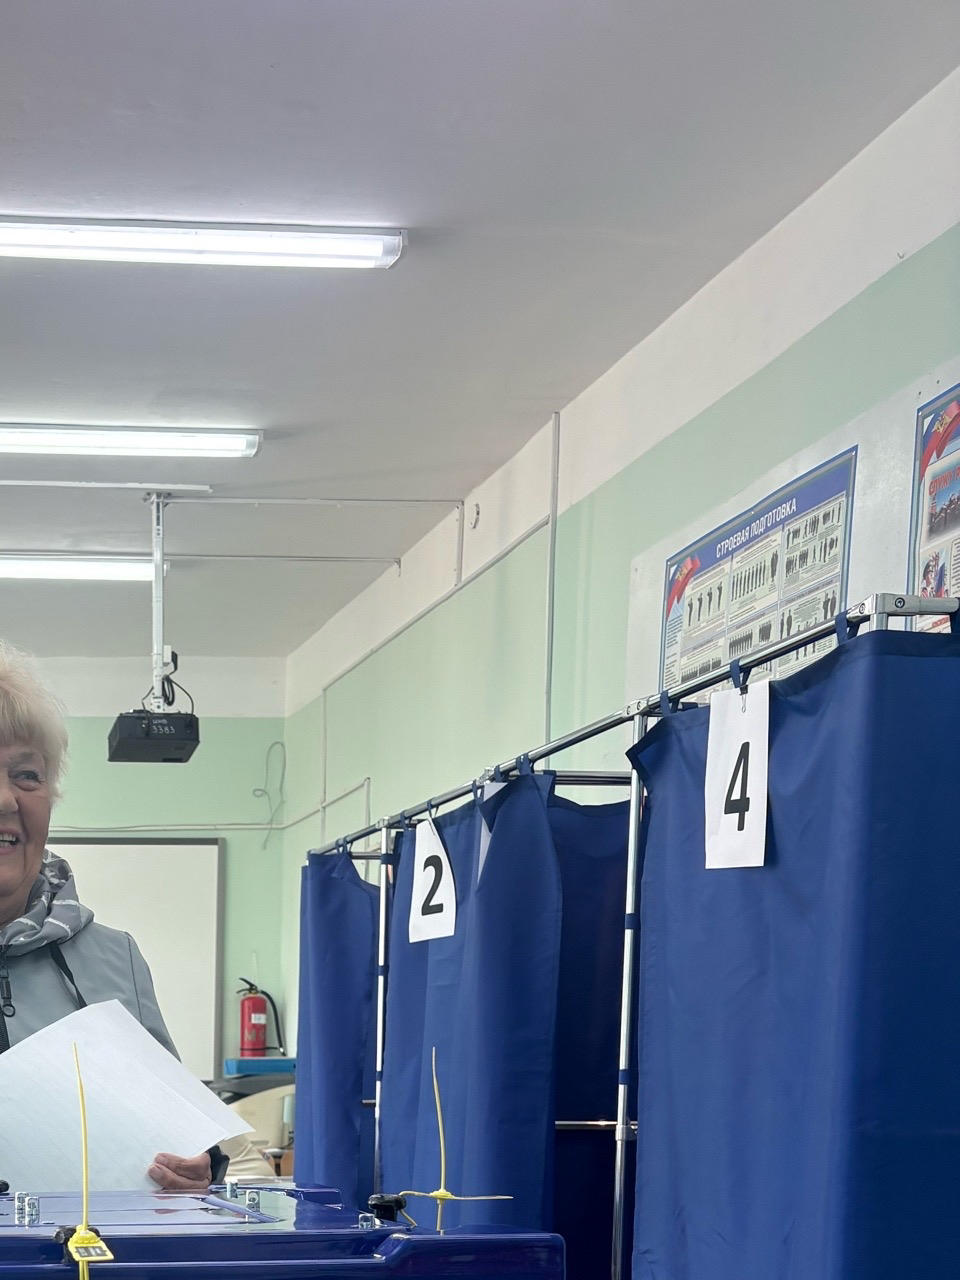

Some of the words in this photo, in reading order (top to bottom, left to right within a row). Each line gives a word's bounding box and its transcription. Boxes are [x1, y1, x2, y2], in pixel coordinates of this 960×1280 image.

[716, 526, 750, 558] СТРОЕВАЯ
[750, 498, 797, 538] ПОДГОТОВКА
[724, 741, 750, 831] 4
[421, 854, 443, 917] 2
